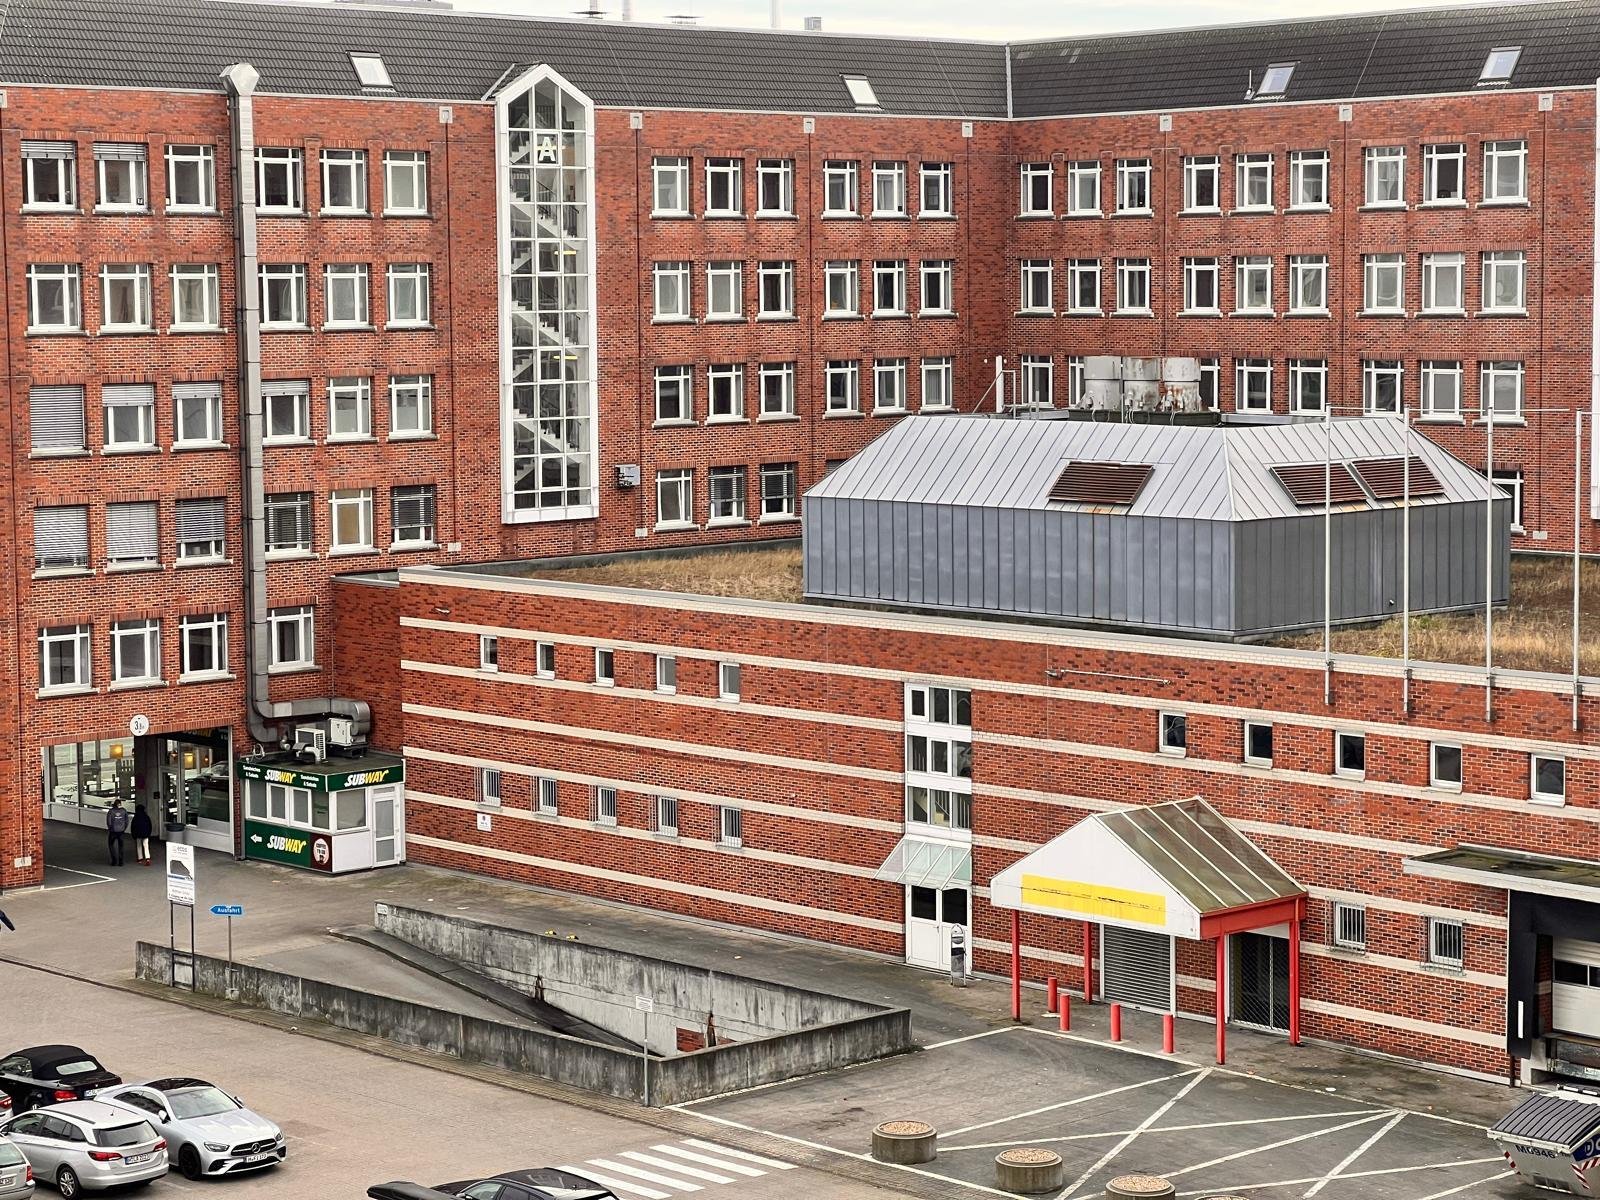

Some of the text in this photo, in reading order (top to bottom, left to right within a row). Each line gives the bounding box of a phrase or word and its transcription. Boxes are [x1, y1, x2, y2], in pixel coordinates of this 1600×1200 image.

[538, 136, 556, 161] A
[264, 769, 297, 784] SUBWAY
[344, 769, 390, 788] SUBWAY
[266, 835, 307, 854] SUBWAY
